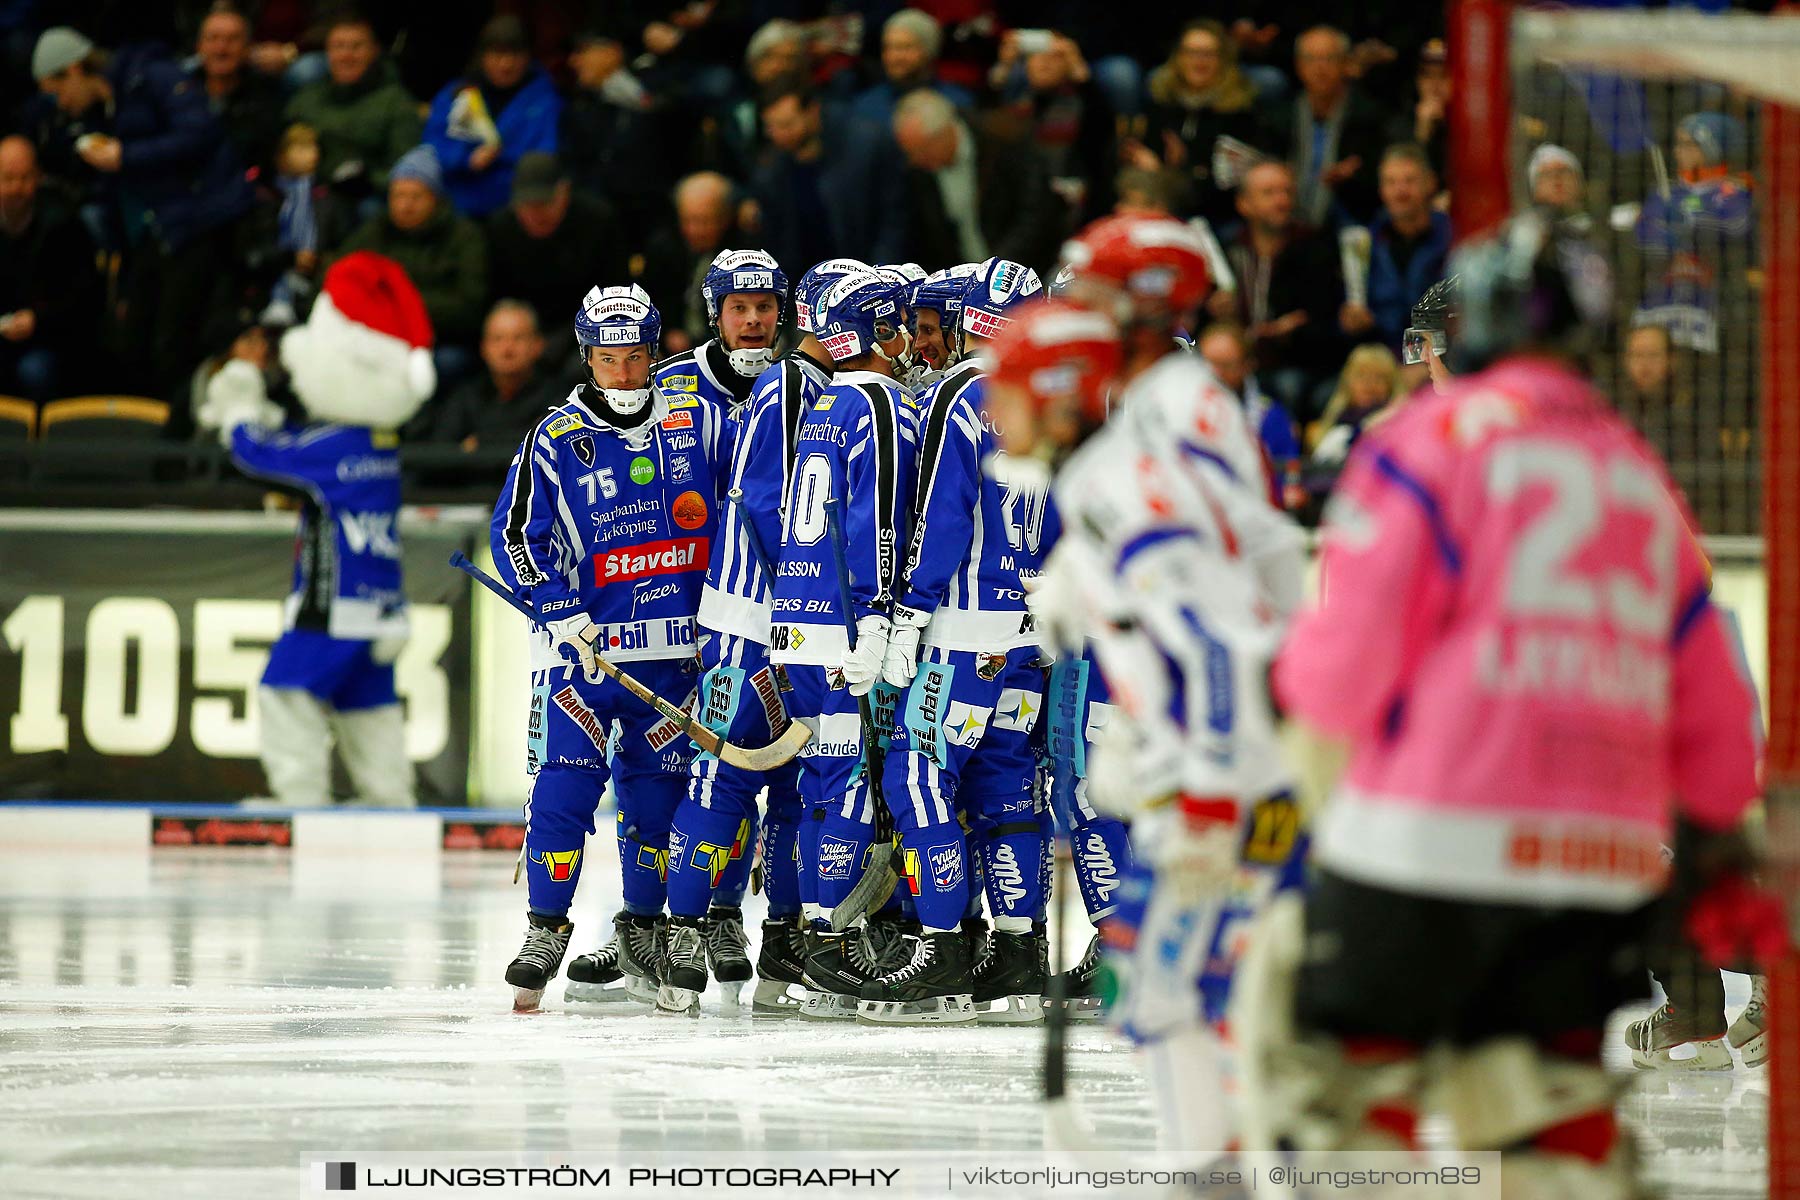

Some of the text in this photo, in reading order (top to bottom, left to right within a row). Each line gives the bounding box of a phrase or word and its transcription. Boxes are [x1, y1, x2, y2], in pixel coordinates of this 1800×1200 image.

[827, 322, 842, 335] 10
[667, 434, 697, 451] Villa
[577, 467, 618, 507] 75
[631, 466, 653, 477] dina
[591, 498, 660, 527] Sparbanken
[1488, 437, 1680, 636] 23
[605, 543, 696, 578] Stavdal
[880, 528, 894, 578] Since
[630, 578, 681, 620] Fazer
[804, 600, 834, 614] BIL
[919, 671, 943, 724] data
[821, 843, 851, 853] Villa
[837, 859, 847, 867] BK
[932, 848, 957, 866] Villa
[992, 843, 1027, 910] Villa
[1084, 833, 1121, 902] Villa
